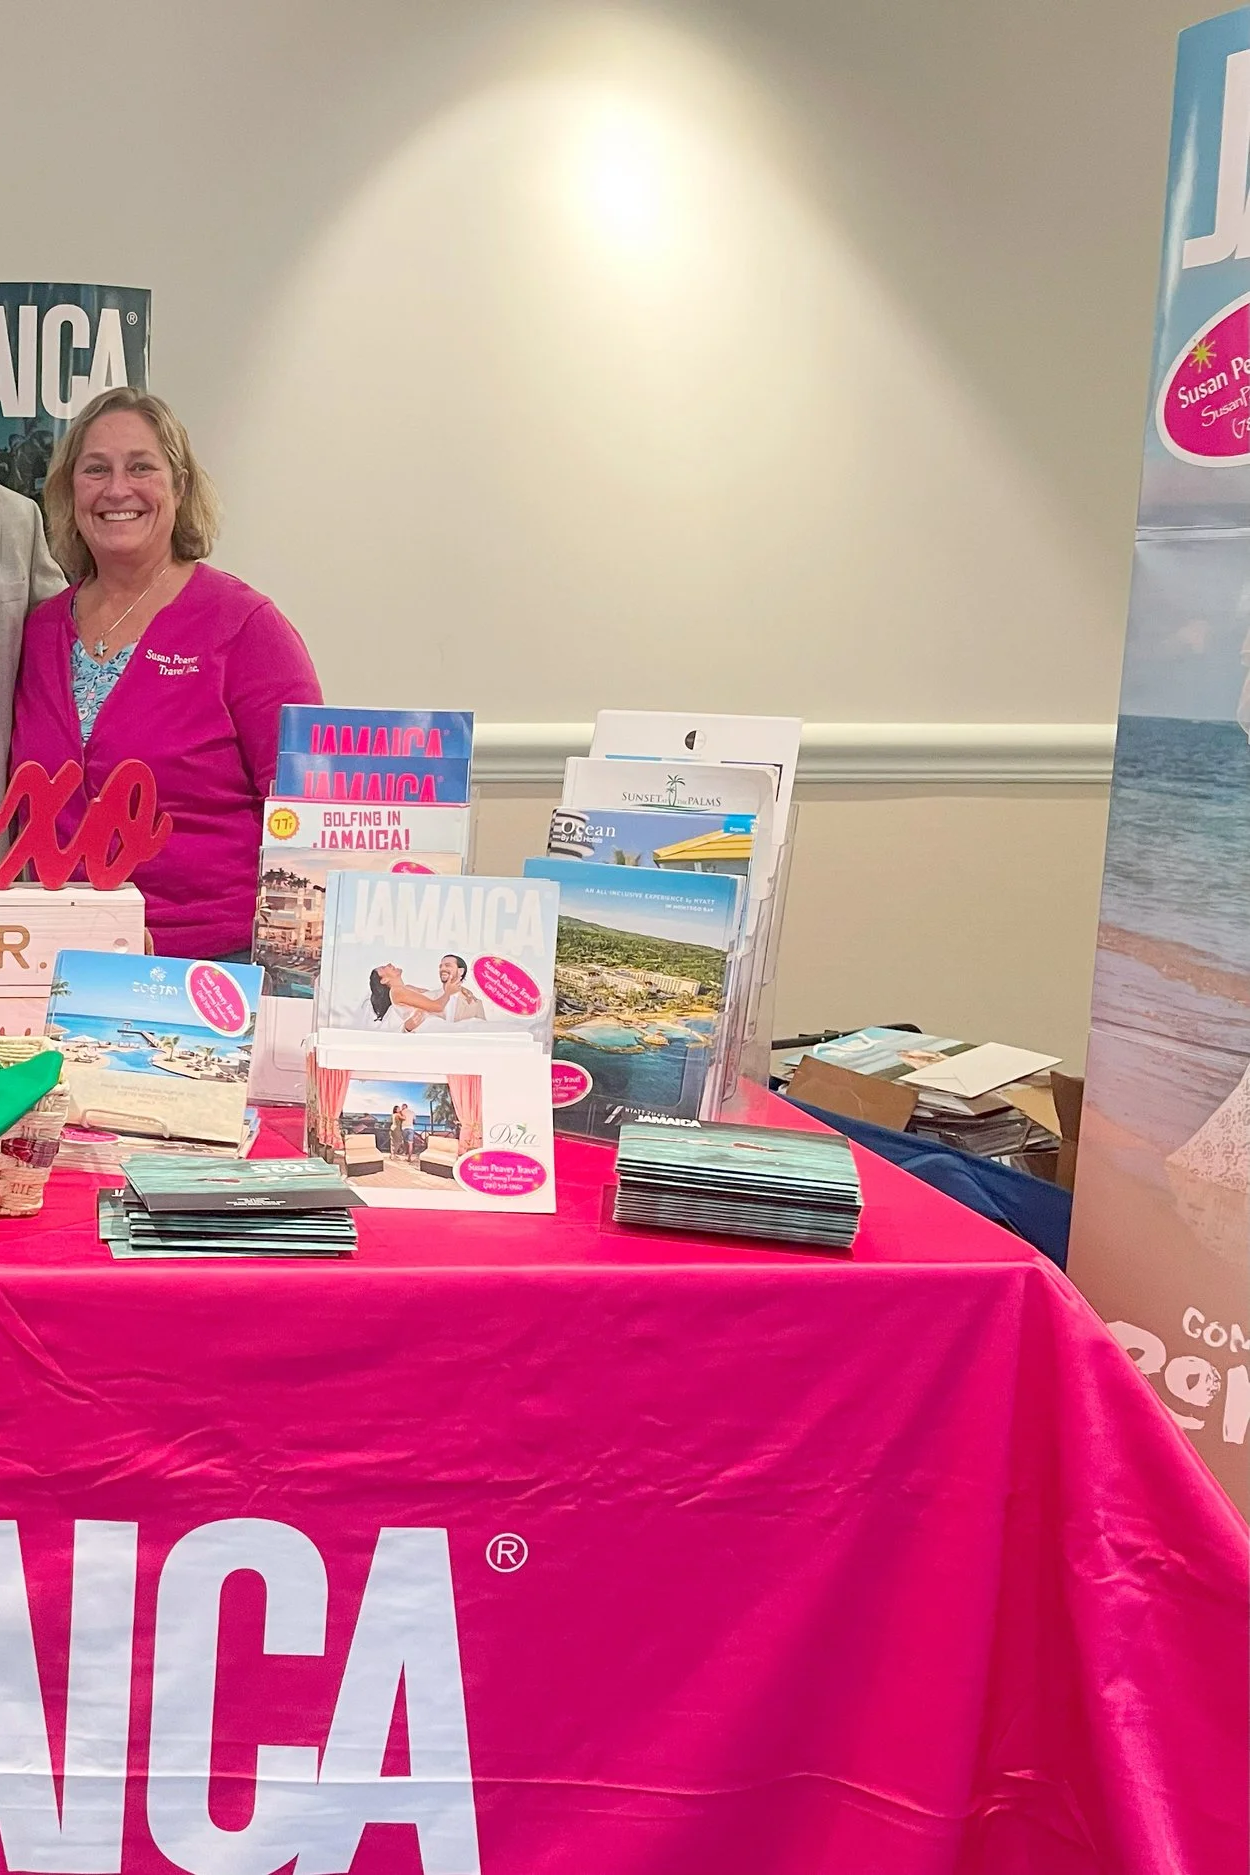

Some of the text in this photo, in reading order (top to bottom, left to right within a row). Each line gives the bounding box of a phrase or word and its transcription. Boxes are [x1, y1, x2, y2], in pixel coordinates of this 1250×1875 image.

[1178, 371, 1228, 409] Susan
[1201, 385, 1250, 427] SusanP
[145, 649, 171, 664] Susan
[622, 792, 662, 804] SUNSET
[688, 796, 722, 807] PALMS
[323, 810, 401, 828] GOLFING IN
[561, 820, 616, 838] Ocean
[312, 829, 411, 851] JAMAICA!
[341, 878, 547, 958] JAMAICA
[634, 1115, 702, 1128] JAMAICA
